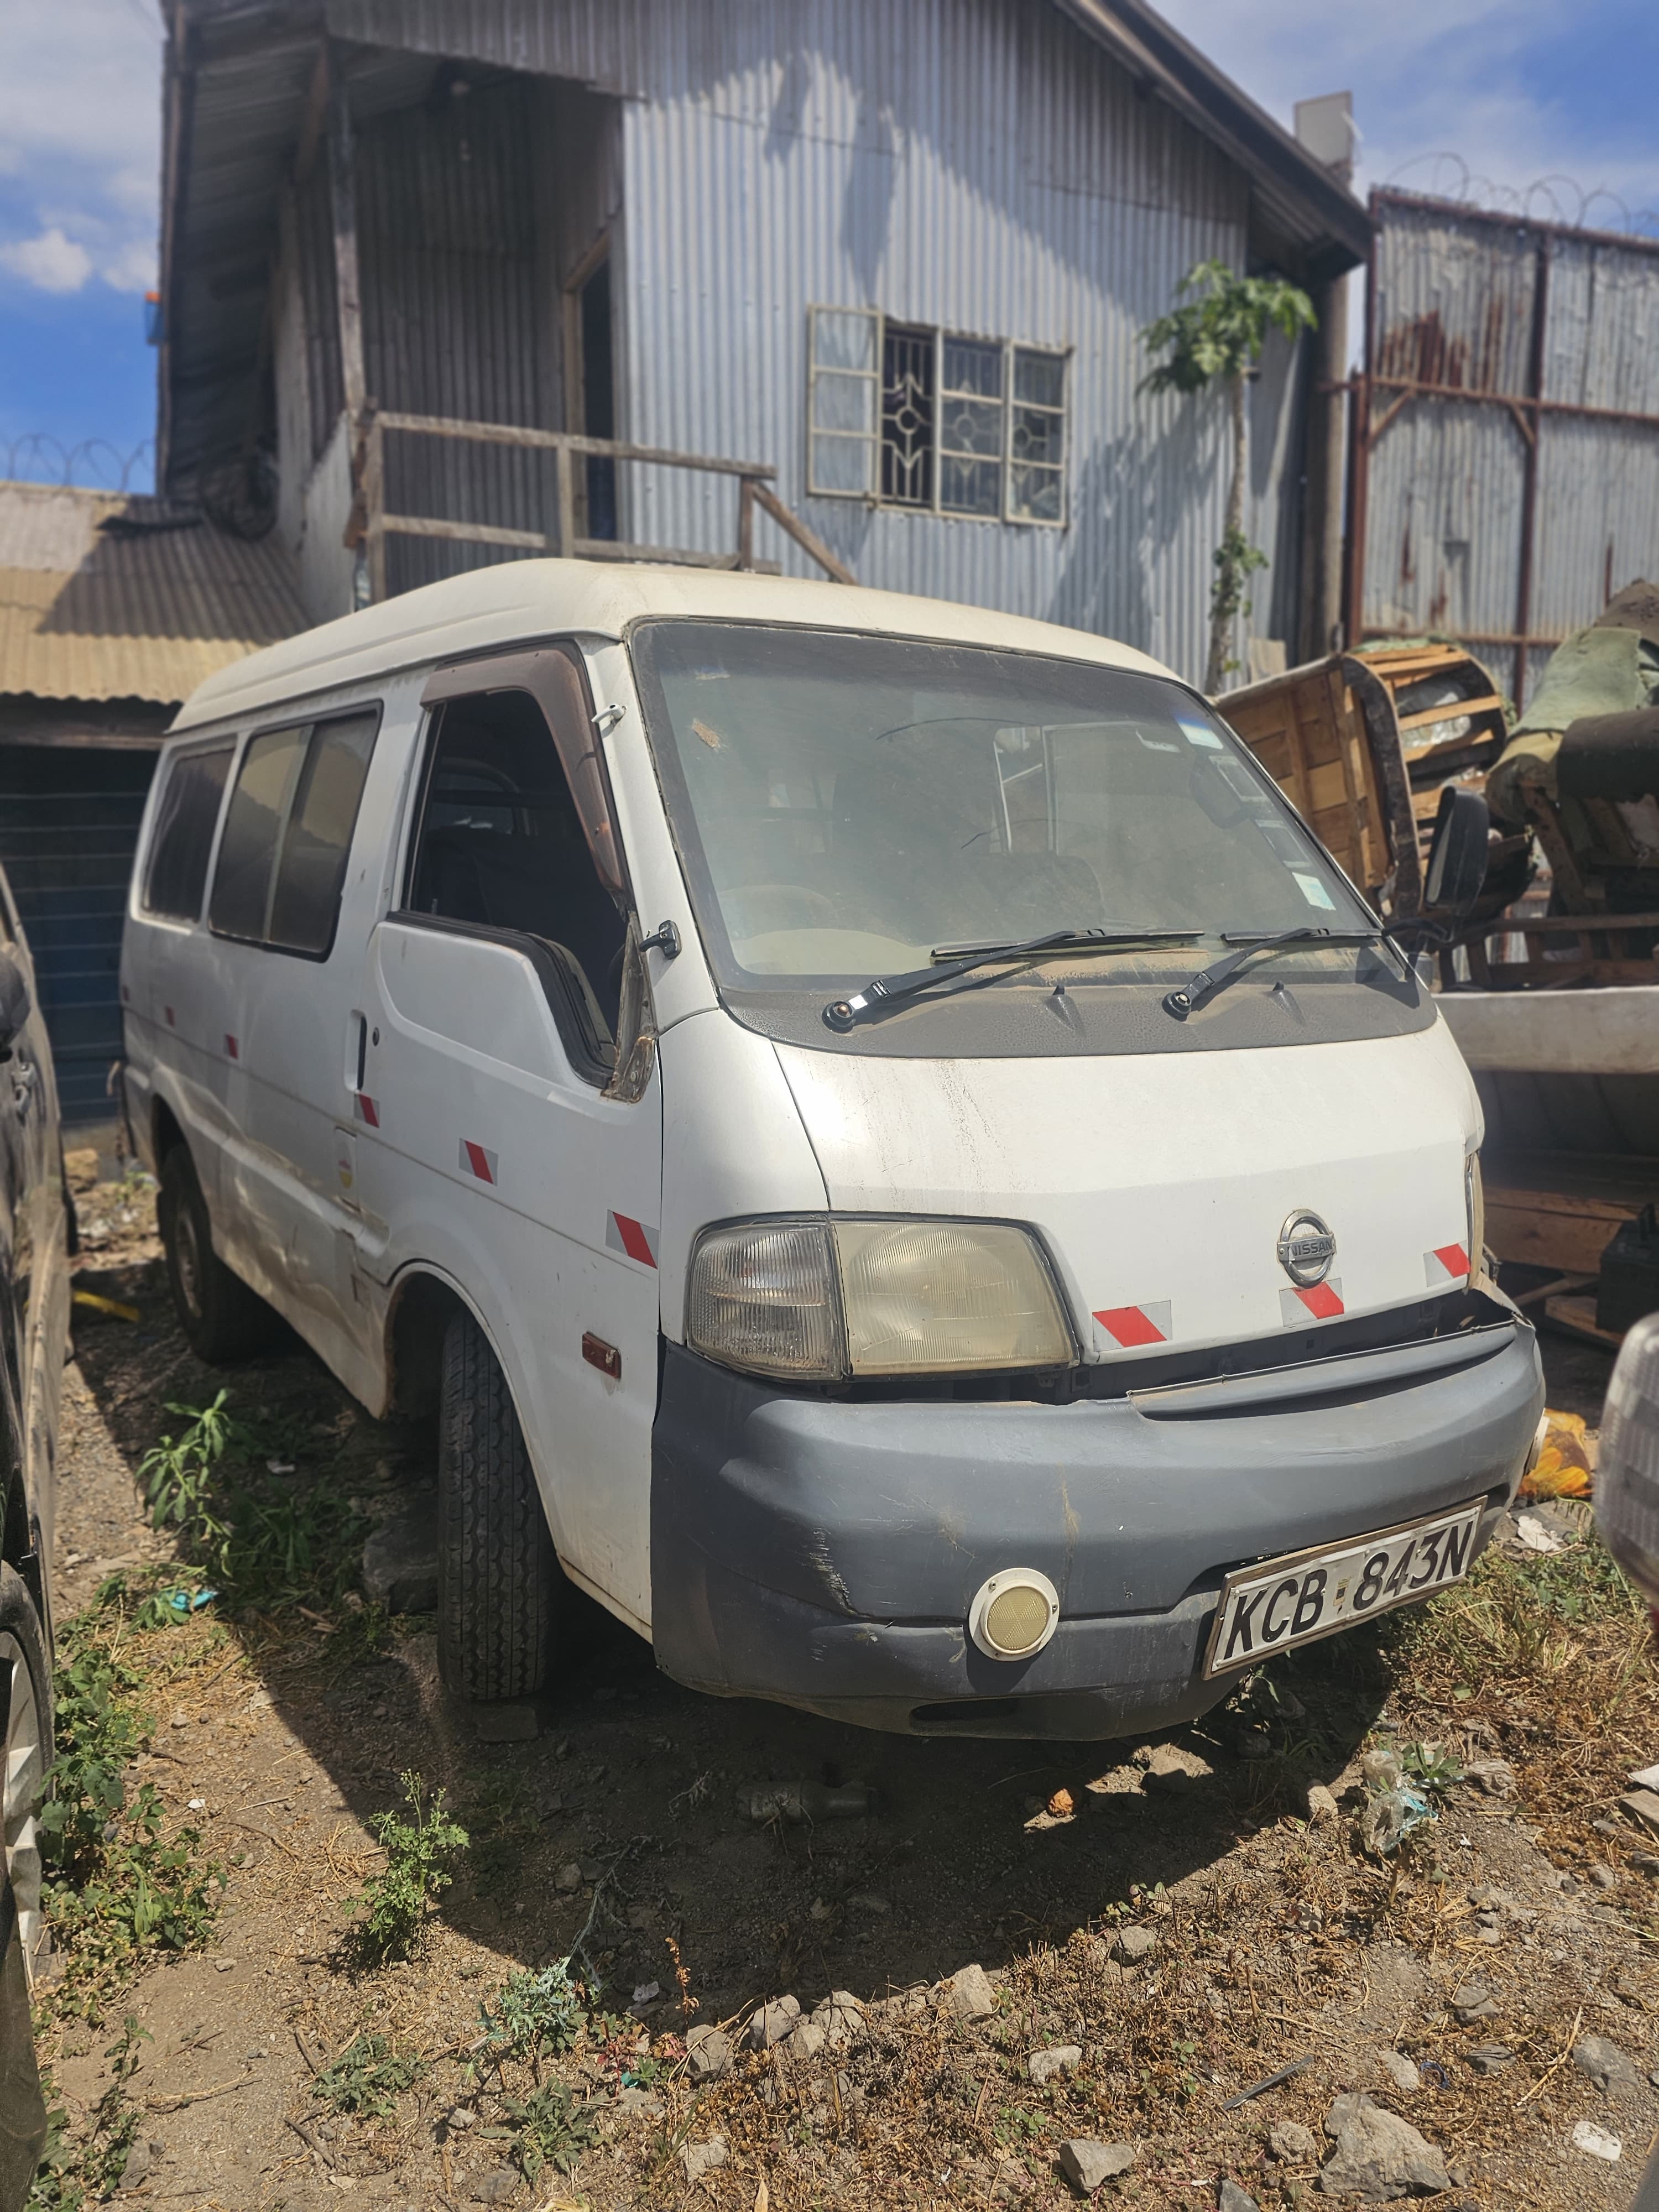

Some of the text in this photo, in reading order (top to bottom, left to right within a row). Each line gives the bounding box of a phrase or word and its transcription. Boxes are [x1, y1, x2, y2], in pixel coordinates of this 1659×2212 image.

[1288, 1239, 1332, 1256] NISSAN
[1224, 1521, 1474, 1660] KCB 843N
